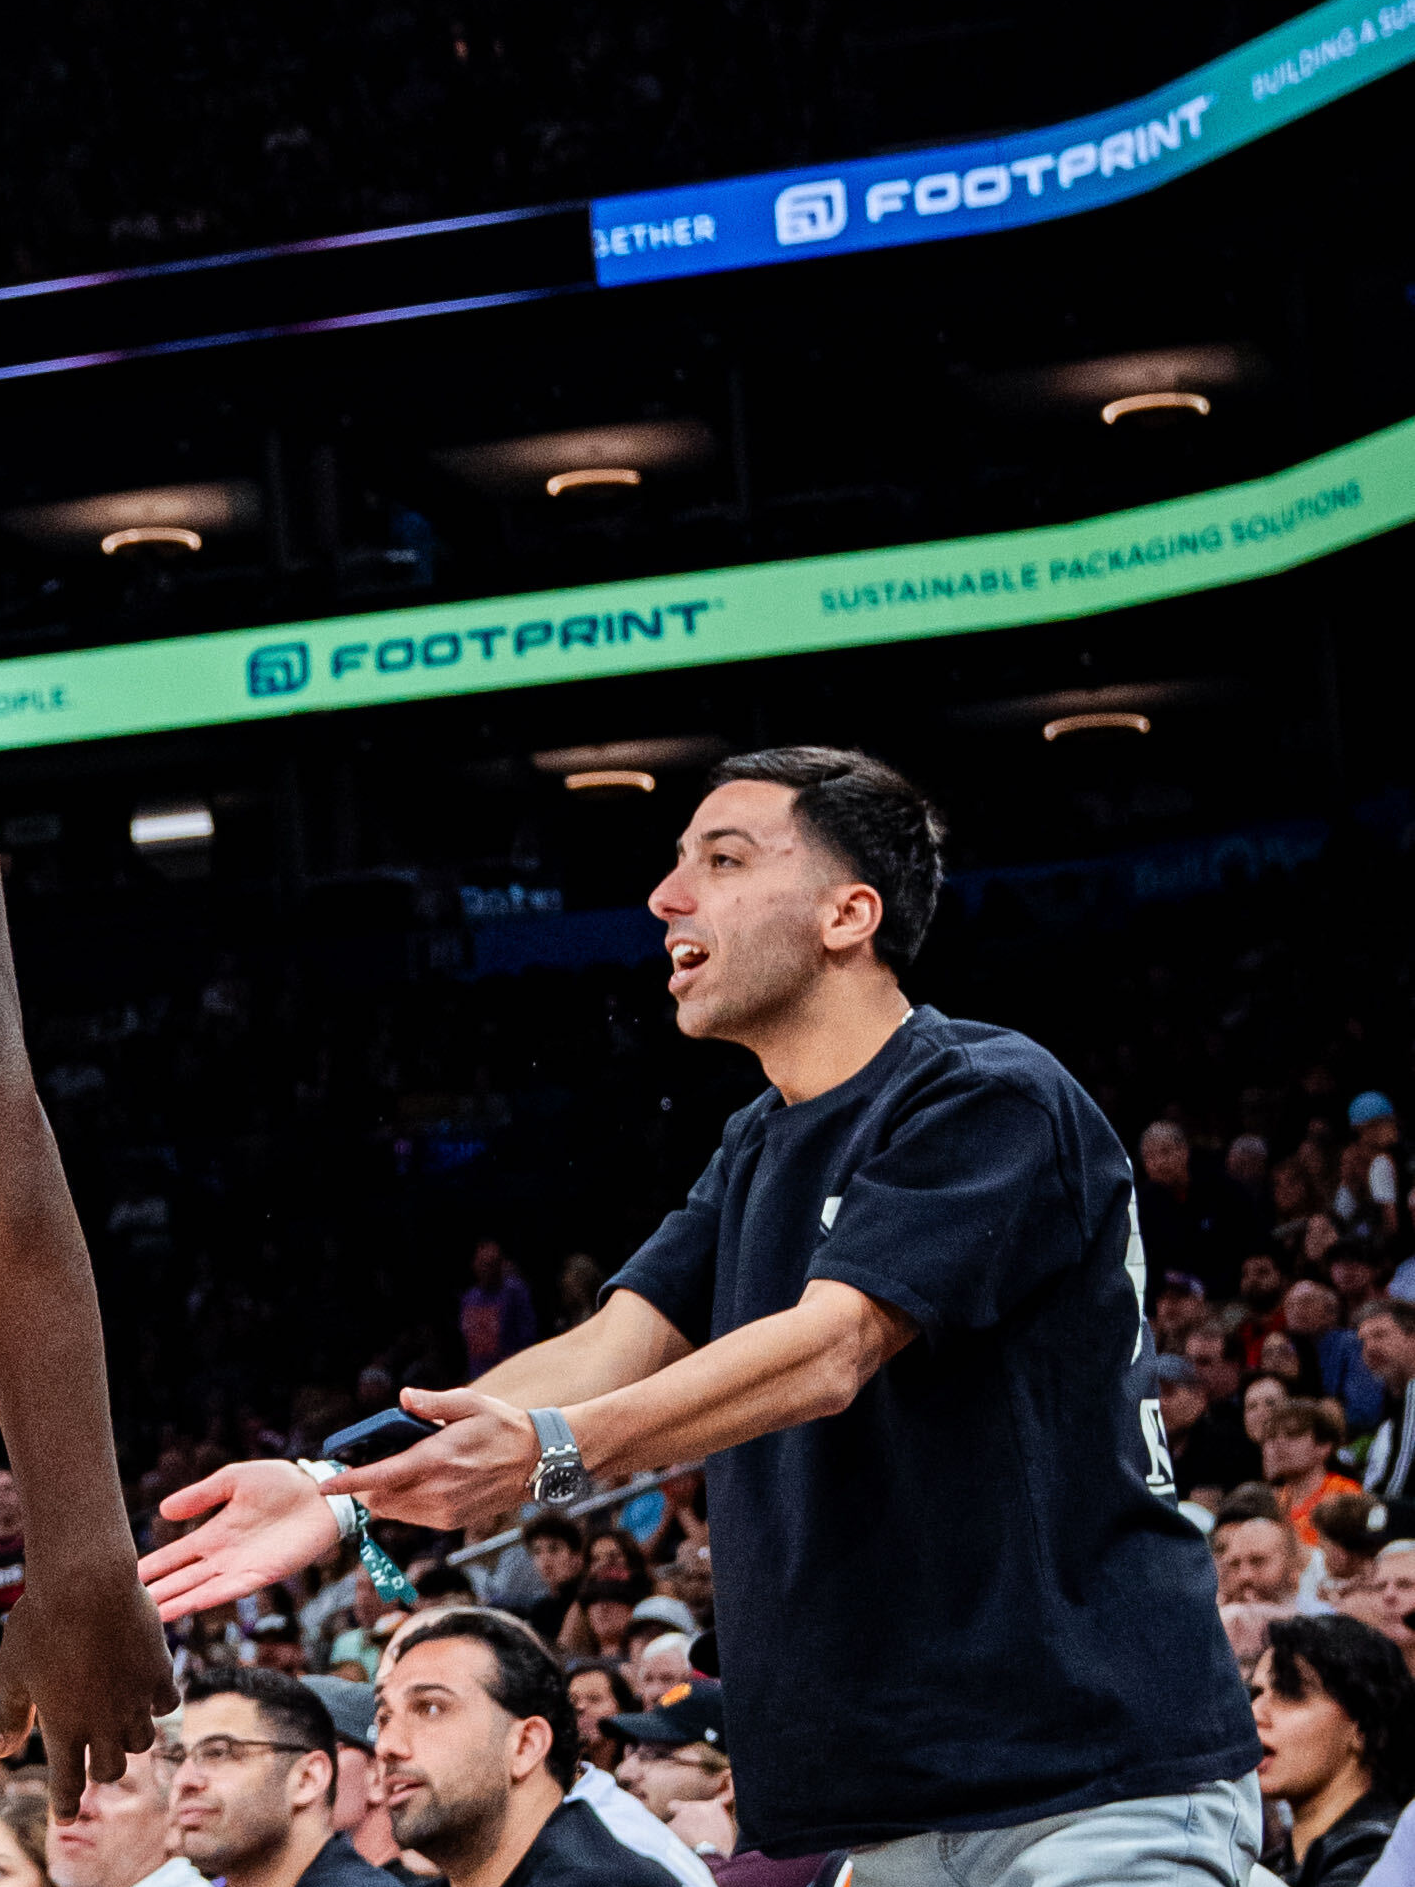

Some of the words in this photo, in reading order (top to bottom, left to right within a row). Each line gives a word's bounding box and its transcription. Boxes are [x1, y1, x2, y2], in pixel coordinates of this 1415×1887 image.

[1251, 26, 1358, 103] BUILDING
[1359, 18, 1378, 44] A
[865, 95, 1211, 224] FOOTPRINT
[820, 560, 1038, 614] SUSTAINABLE
[1049, 521, 1225, 583] PACKAGING
[1229, 479, 1363, 549] SOLUTIONS
[330, 599, 710, 679] FOOTPRINT
